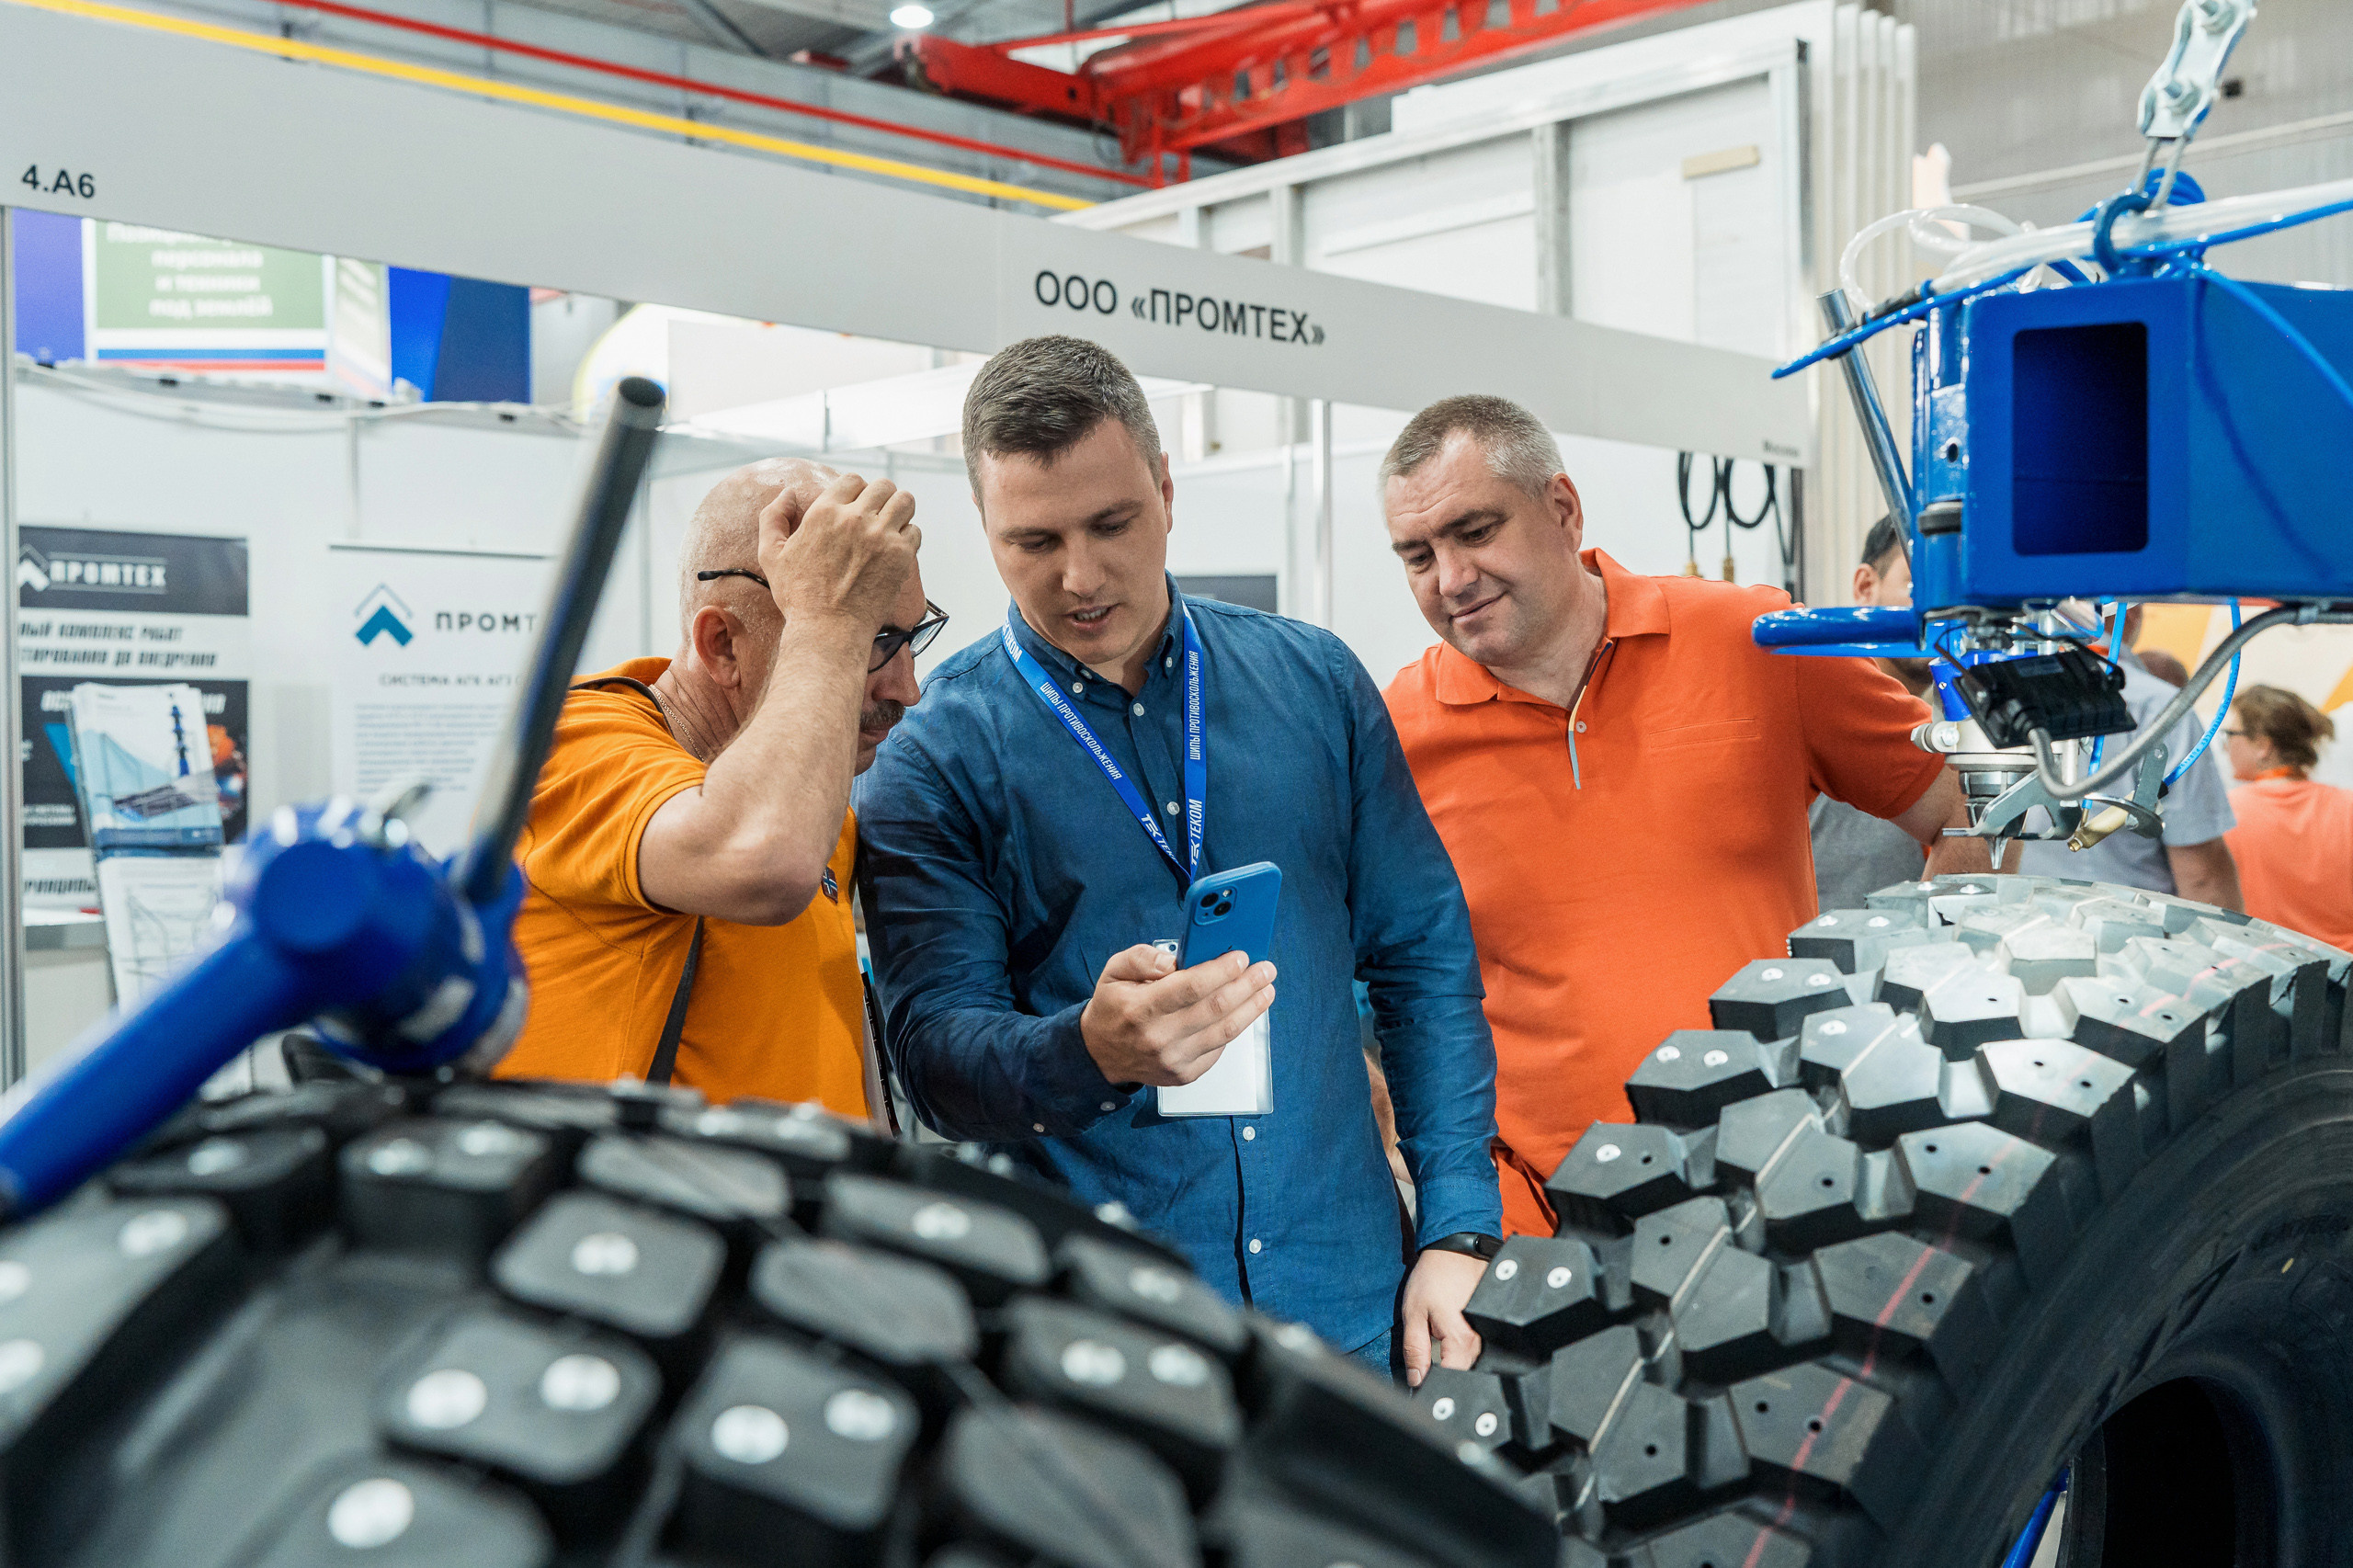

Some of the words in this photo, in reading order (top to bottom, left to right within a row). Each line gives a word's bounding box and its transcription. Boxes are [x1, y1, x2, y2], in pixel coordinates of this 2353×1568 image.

[1035, 269, 1119, 315] ООО
[1131, 289, 1325, 346] «ПРОМТЕХ»
[436, 611, 537, 631] ПРОМТ
[1188, 650, 1200, 733] ПРОТИВОСКОЛЬЖЕНИЯ
[1040, 681, 1061, 707] ШИПЫ
[1056, 699, 1122, 780] ПРОТИВОСКОЛЬЖЕНИЯ
[1189, 734, 1200, 760] ШИПЫ
